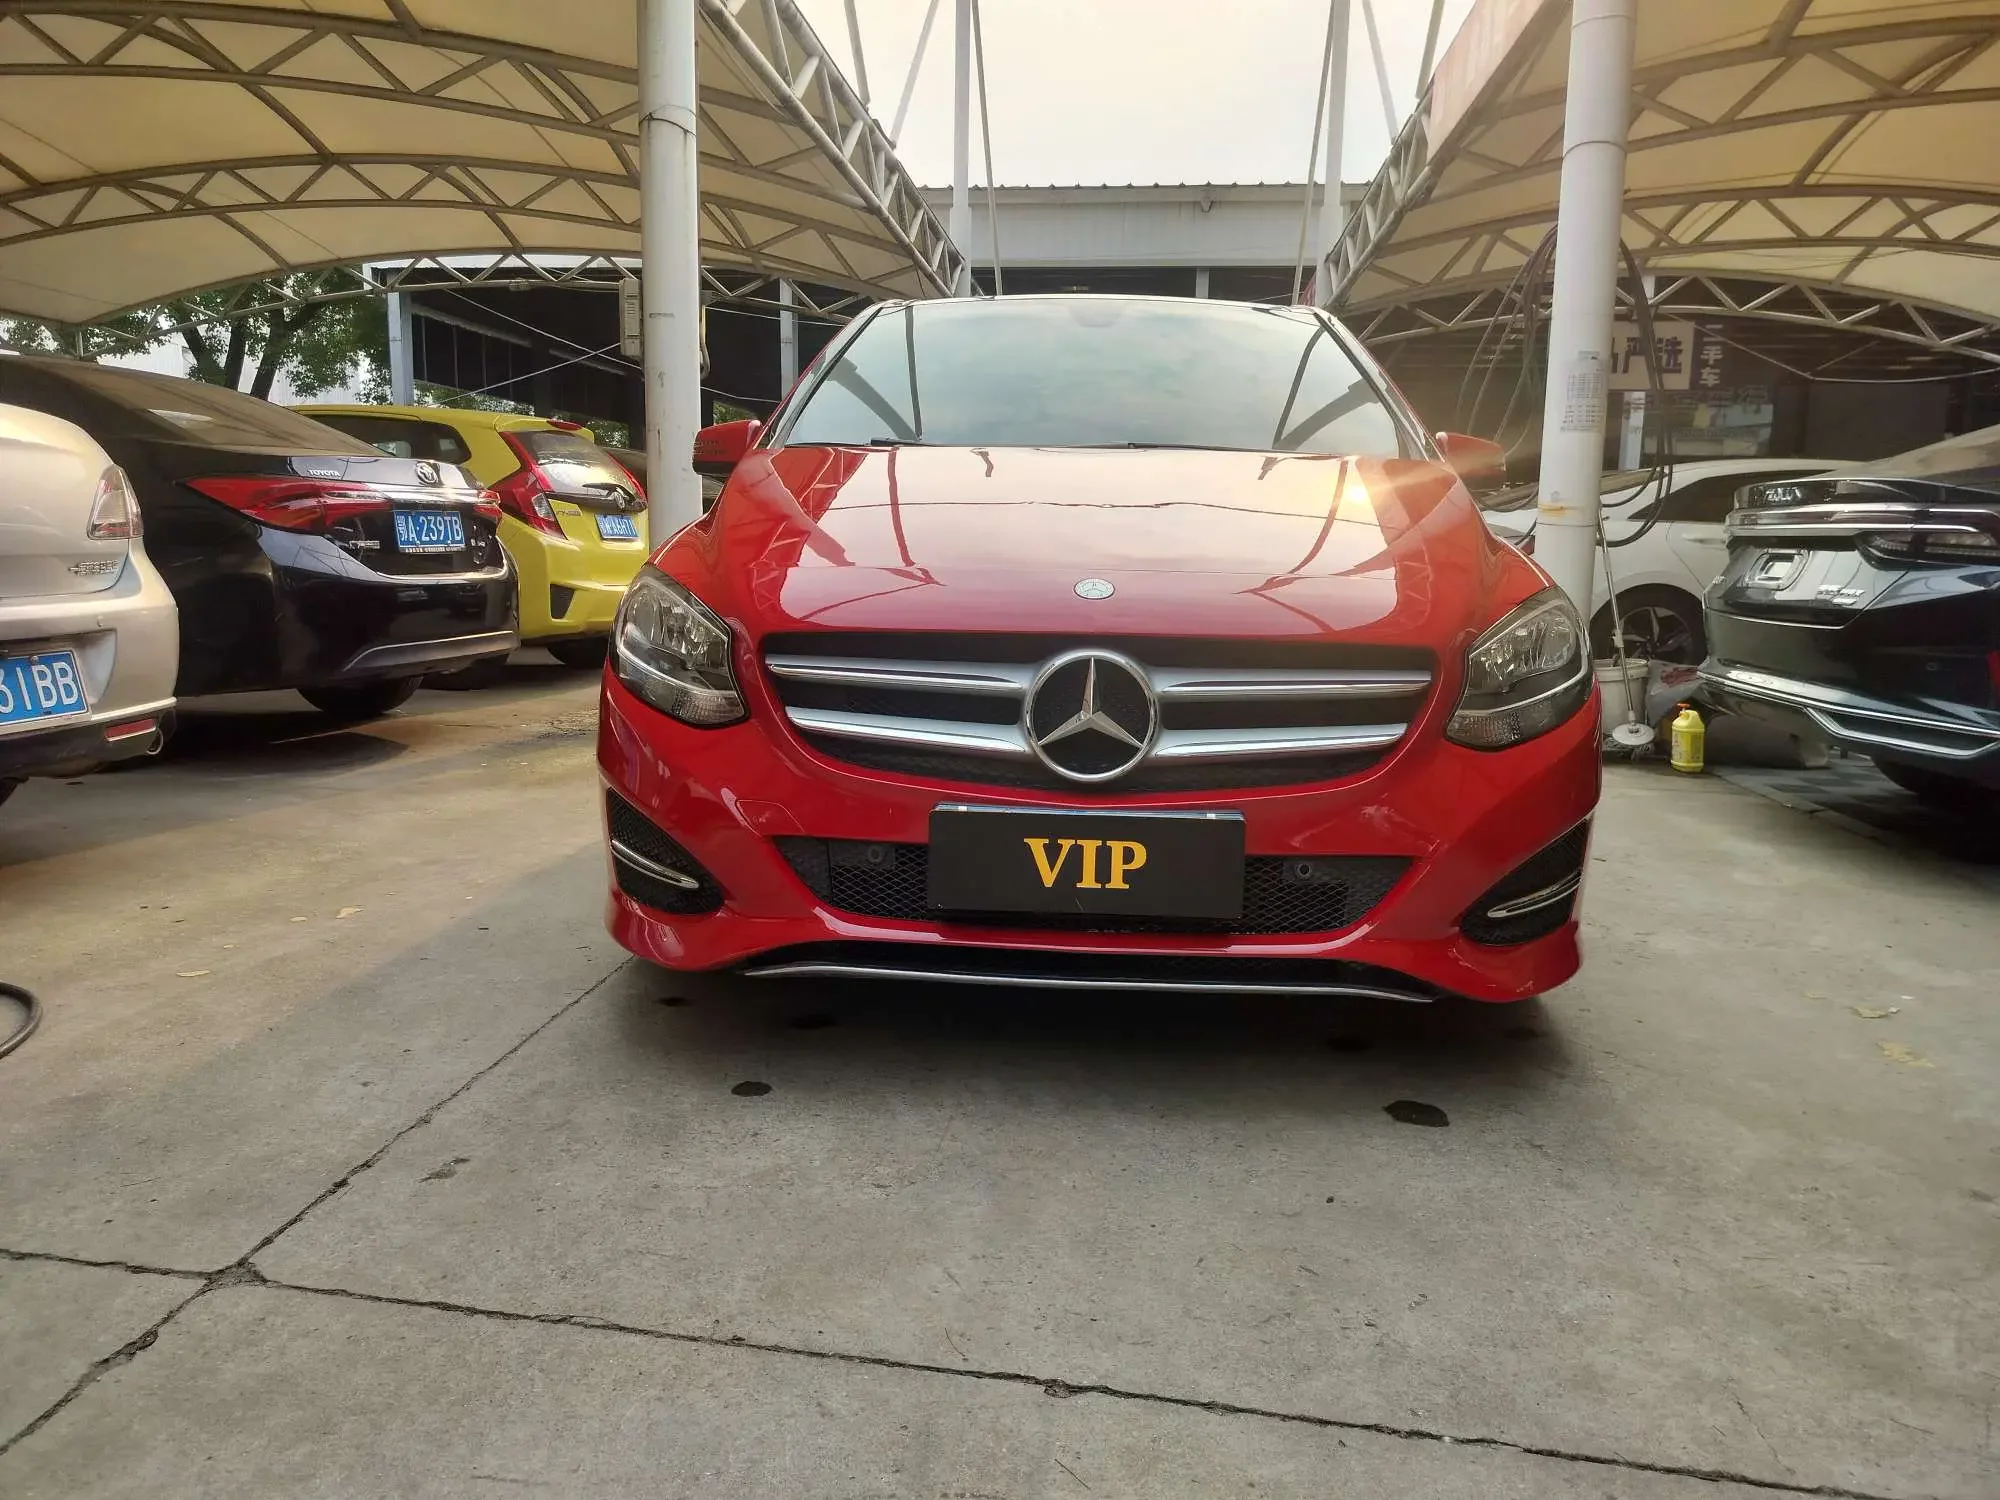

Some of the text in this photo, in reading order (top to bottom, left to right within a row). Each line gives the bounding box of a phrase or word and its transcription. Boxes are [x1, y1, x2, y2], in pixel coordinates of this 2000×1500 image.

[1700, 324, 1724, 388] 二手车
[308, 469, 341, 478] TOYOTA
[1024, 838, 1147, 889] VIP
